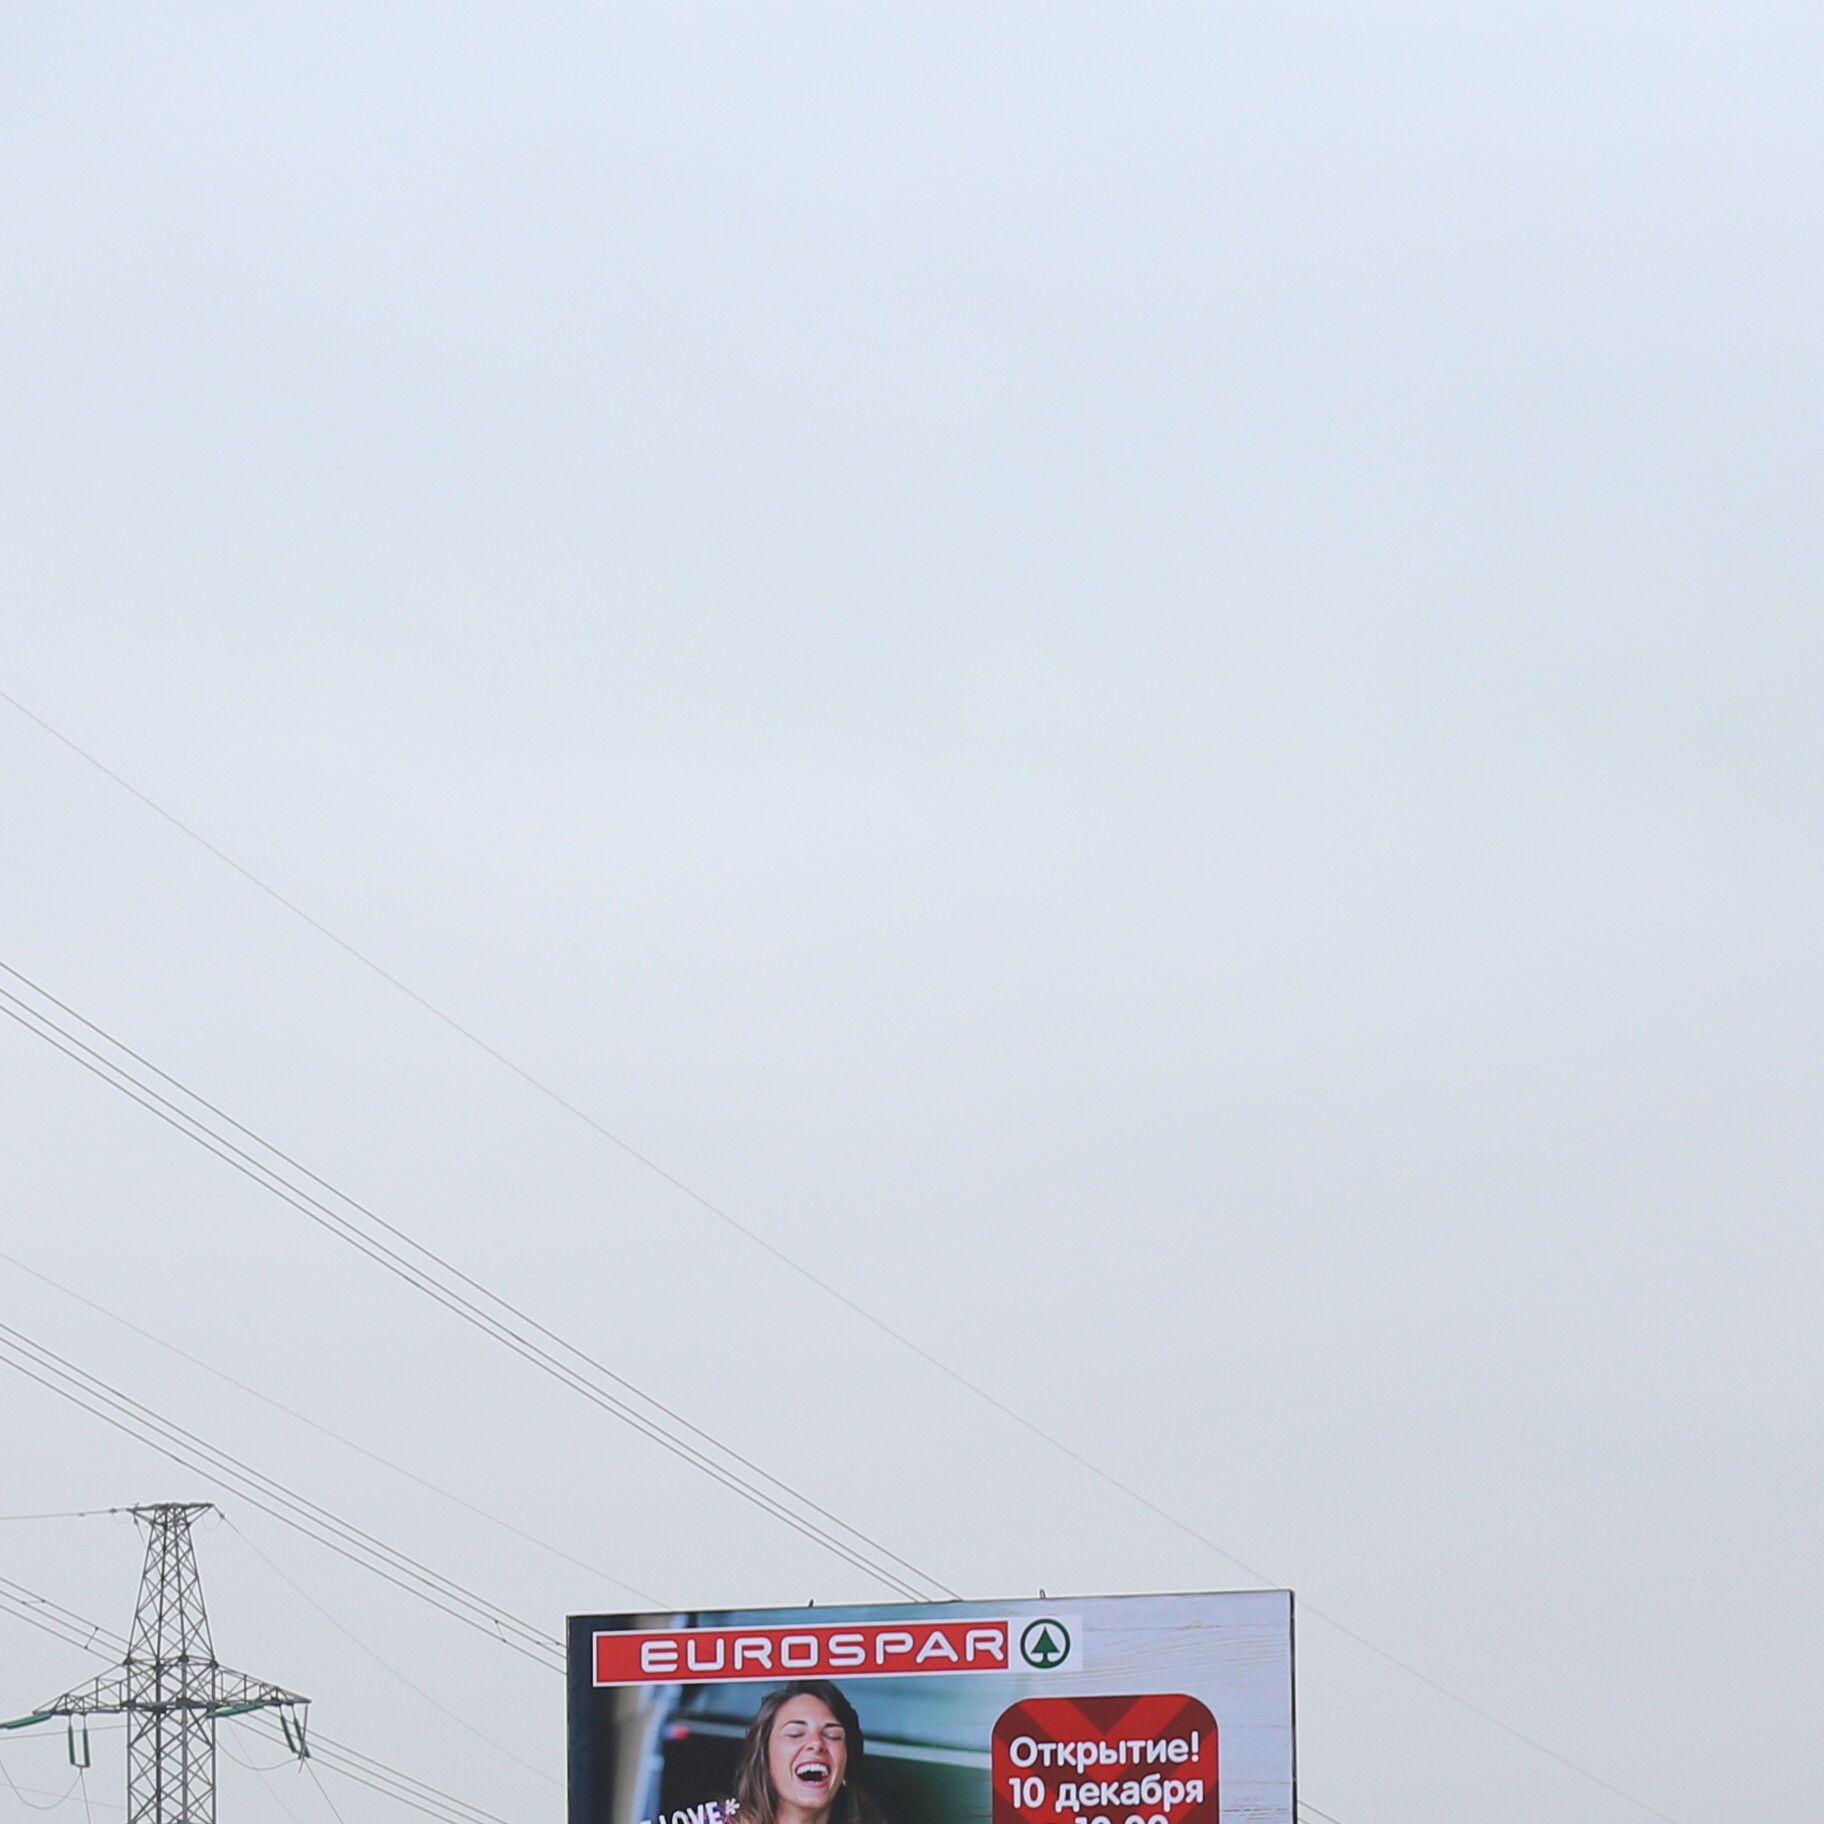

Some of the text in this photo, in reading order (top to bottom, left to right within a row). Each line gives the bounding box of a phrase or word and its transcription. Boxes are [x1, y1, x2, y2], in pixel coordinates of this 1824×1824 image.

[640, 1628, 1005, 1673] EUROSPAR
[1009, 1730, 1200, 1774] Открытие!
[1008, 1773, 1204, 1813] 10 декабря
